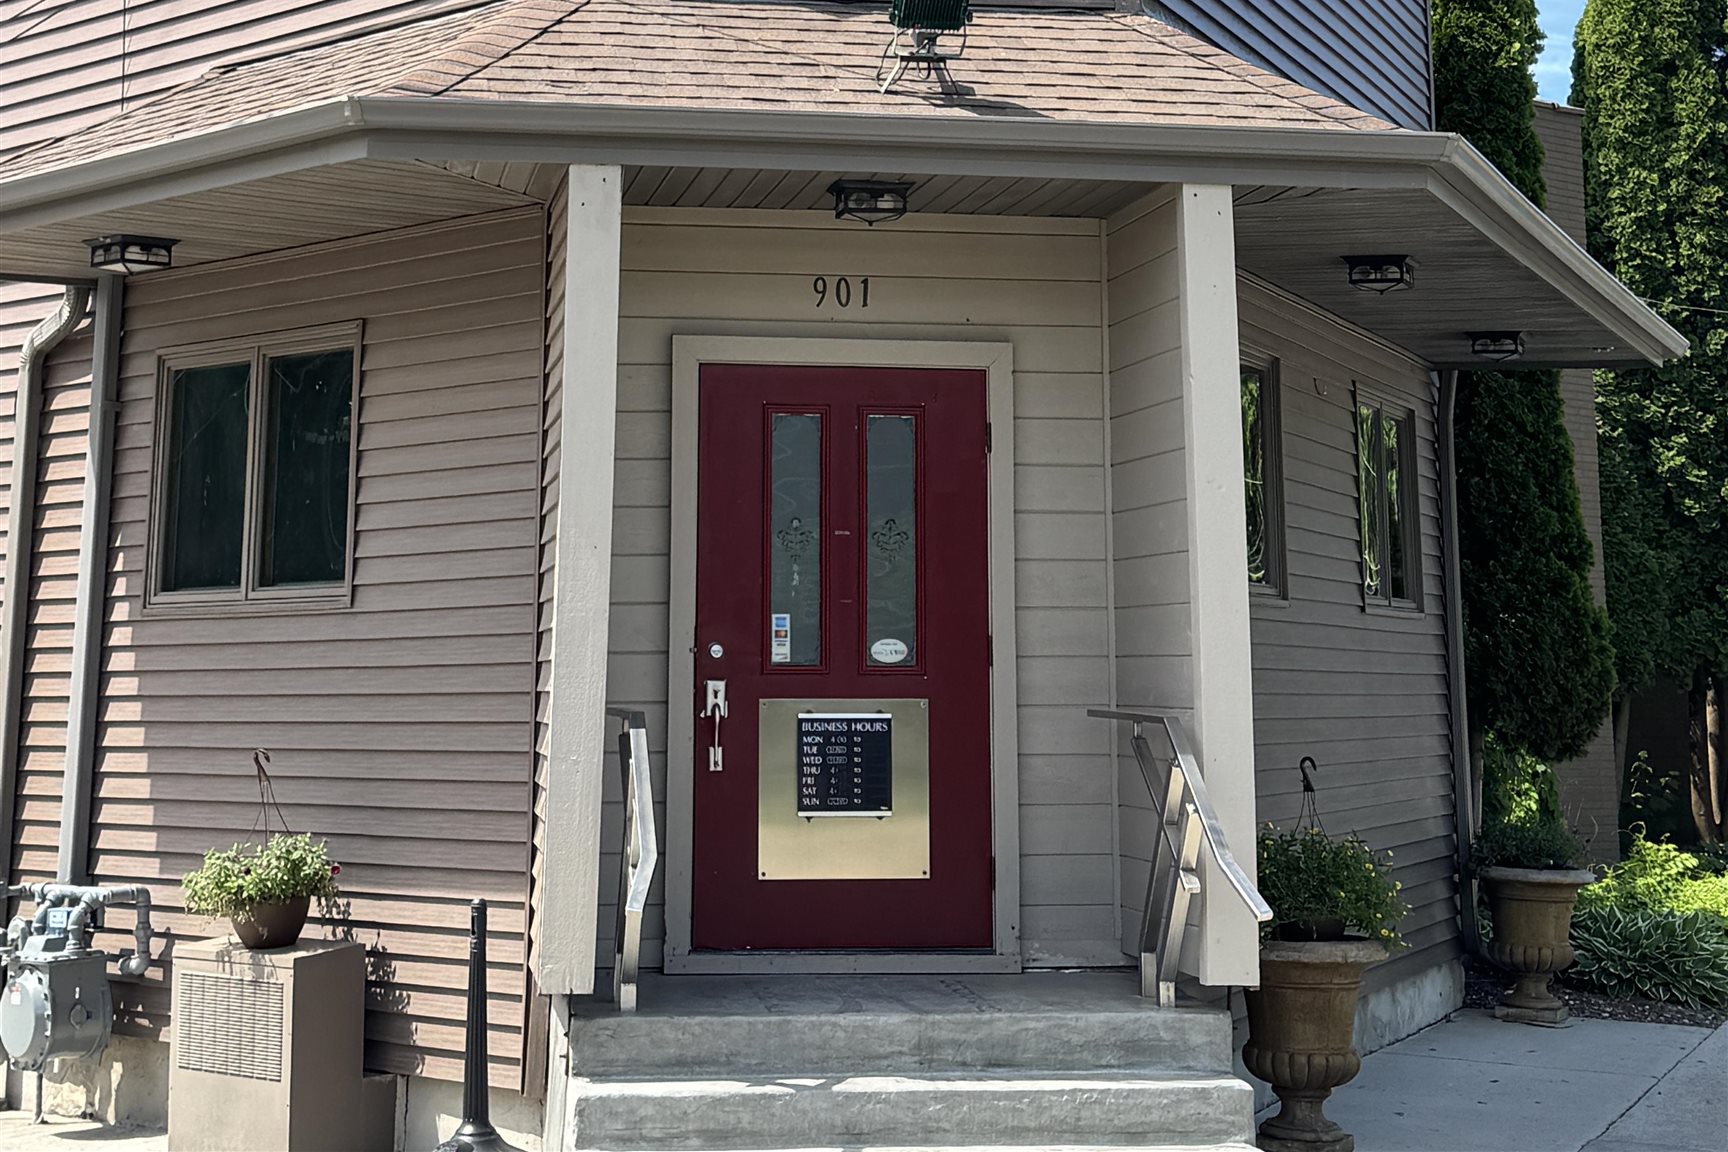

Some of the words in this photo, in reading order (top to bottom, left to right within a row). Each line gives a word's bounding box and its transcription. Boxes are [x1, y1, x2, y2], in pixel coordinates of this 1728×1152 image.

[813, 276, 869, 308] 901
[802, 721, 848, 732] BUSINESS
[852, 721, 888, 732] HOURS
[803, 736, 824, 744] MON
[803, 746, 818, 754] TUE
[803, 756, 823, 764] WED
[803, 766, 821, 775] THU
[802, 777, 815, 785] FRI
[802, 787, 817, 795] SAT
[802, 797, 820, 806] SUN
